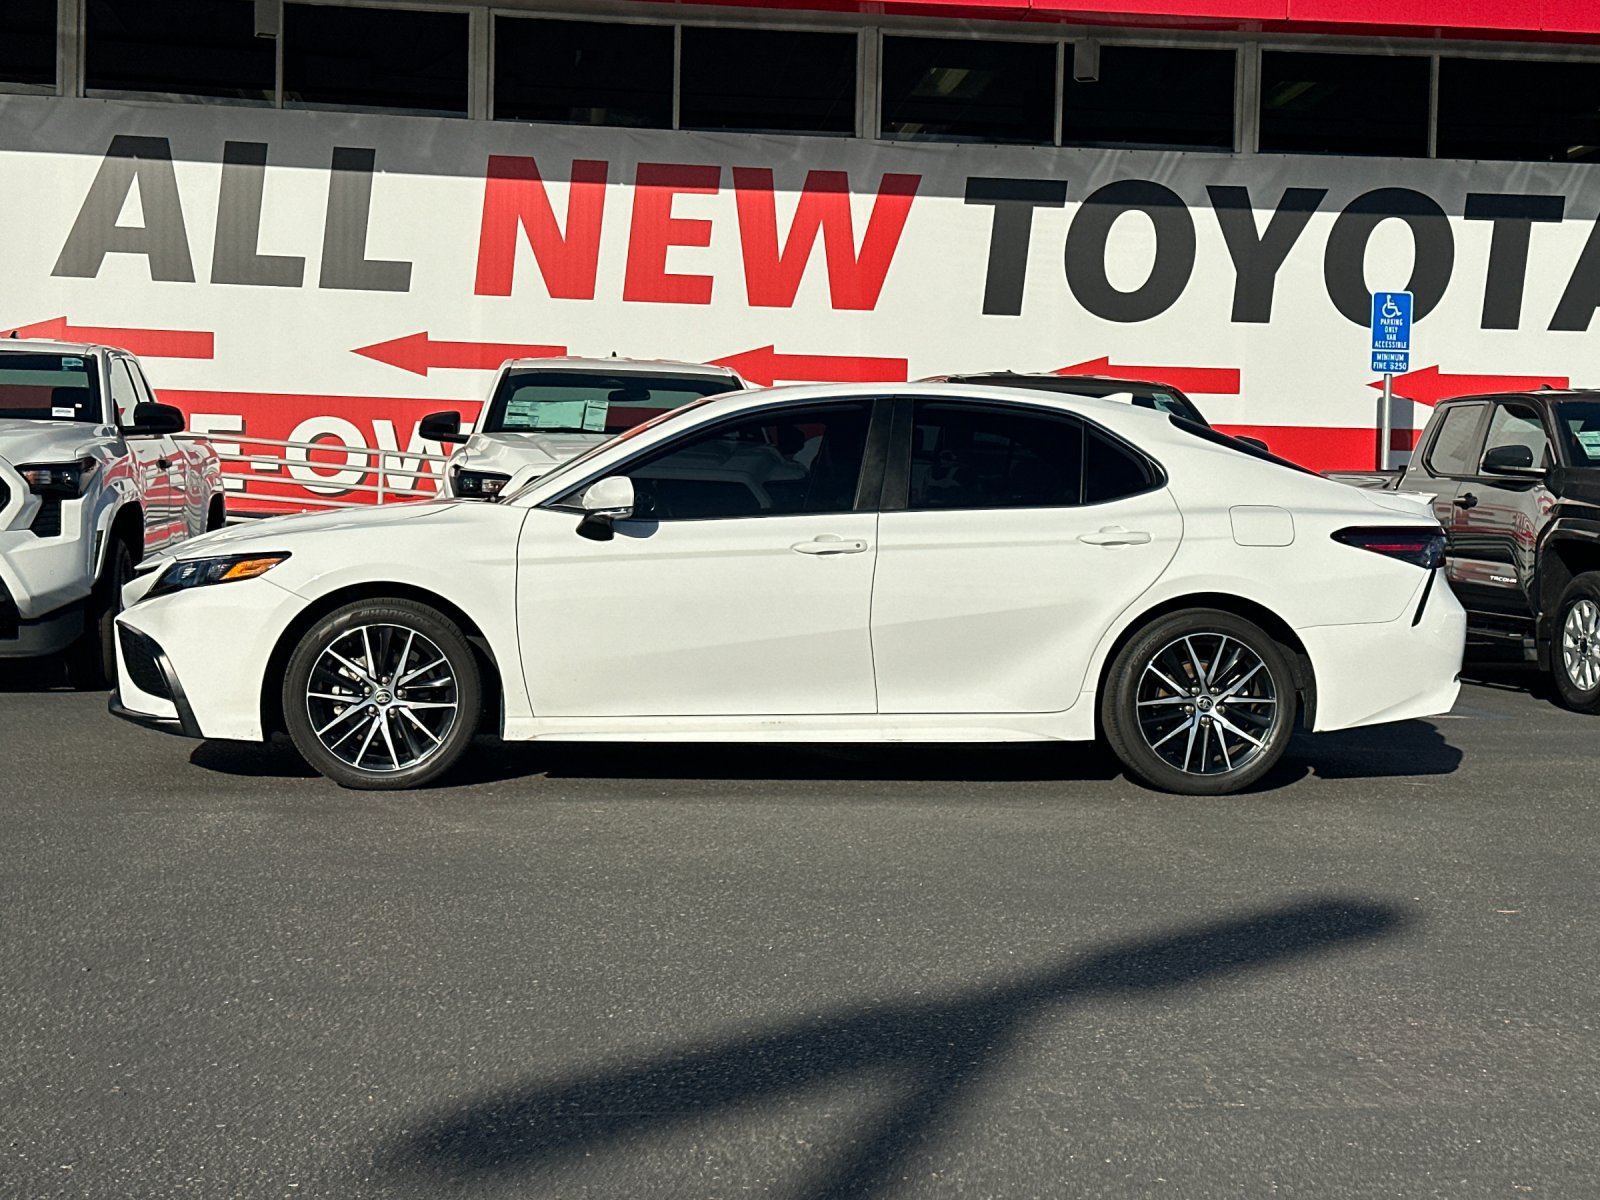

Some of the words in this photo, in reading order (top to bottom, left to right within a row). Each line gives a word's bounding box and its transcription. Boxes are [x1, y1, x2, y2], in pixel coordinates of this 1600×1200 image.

[50, 135, 413, 292] ALL
[474, 154, 922, 311] NEW
[1380, 318, 1403, 326] PARKING
[1376, 353, 1404, 361] MINIMUM
[1373, 361, 1387, 370] FINE
[1389, 362, 1407, 370] $250
